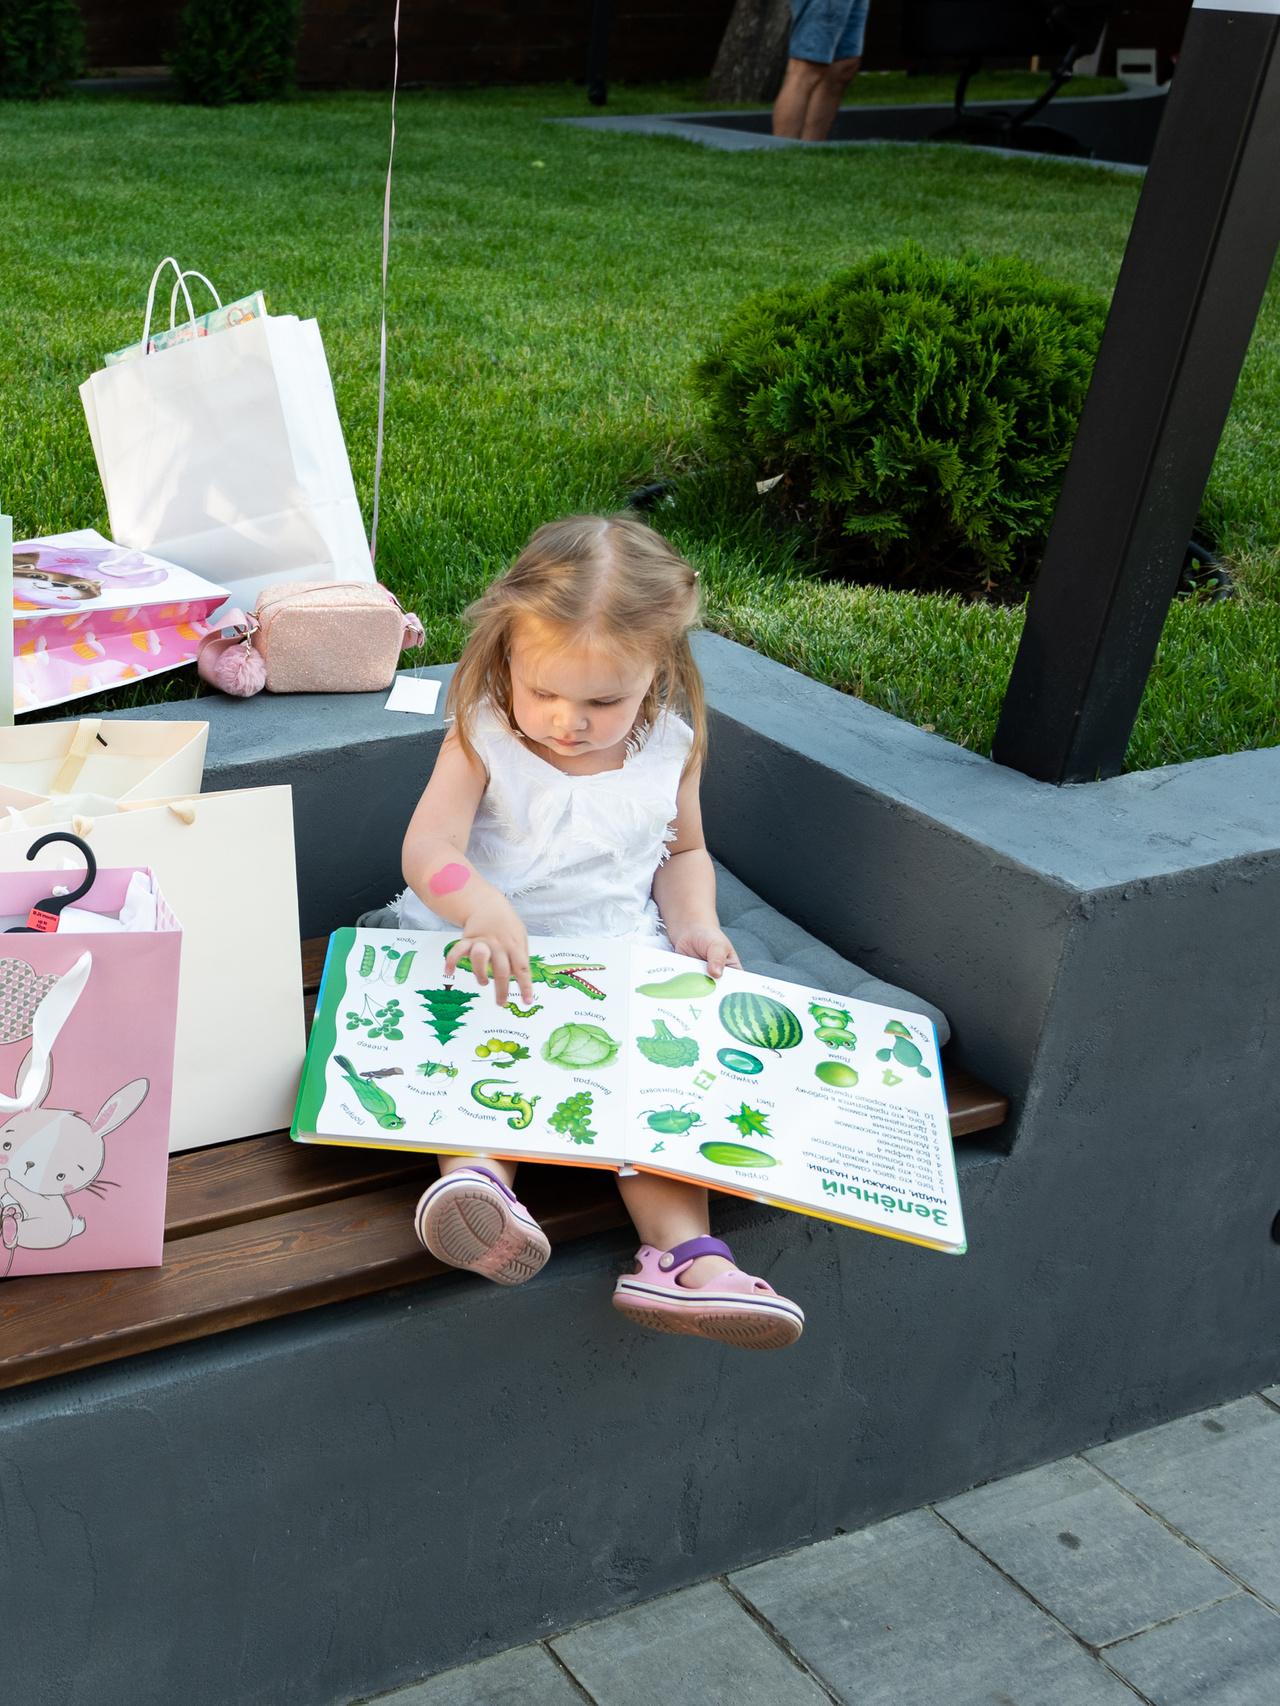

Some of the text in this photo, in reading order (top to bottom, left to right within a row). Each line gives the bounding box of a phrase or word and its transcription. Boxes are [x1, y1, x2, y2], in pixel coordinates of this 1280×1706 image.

[396, 937, 417, 945] Горох
[549, 952, 590, 961] Крокодил
[811, 996, 846, 1008] Лягушка
[574, 1011, 606, 1022] Капуста
[482, 1029, 530, 1040] Крыжовник
[908, 1024, 930, 1044] Кактус
[356, 1041, 389, 1052] Клевер
[827, 1053, 851, 1063] Лайм
[720, 1070, 758, 1085] Изумруд
[405, 1084, 448, 1096] Кузнечик
[573, 1077, 612, 1096] Виноград
[756, 1098, 775, 1108] Лист
[339, 1103, 365, 1126] Попугай
[457, 1106, 497, 1122] Ящерица
[735, 1170, 769, 1181] Огурец
[807, 1162, 850, 1179] НАЗОВИ:
[861, 1177, 906, 1195] ПОКАЖИ
[822, 1179, 948, 1226] Зелёный
[907, 1188, 947, 1206] НАЙДИ,
